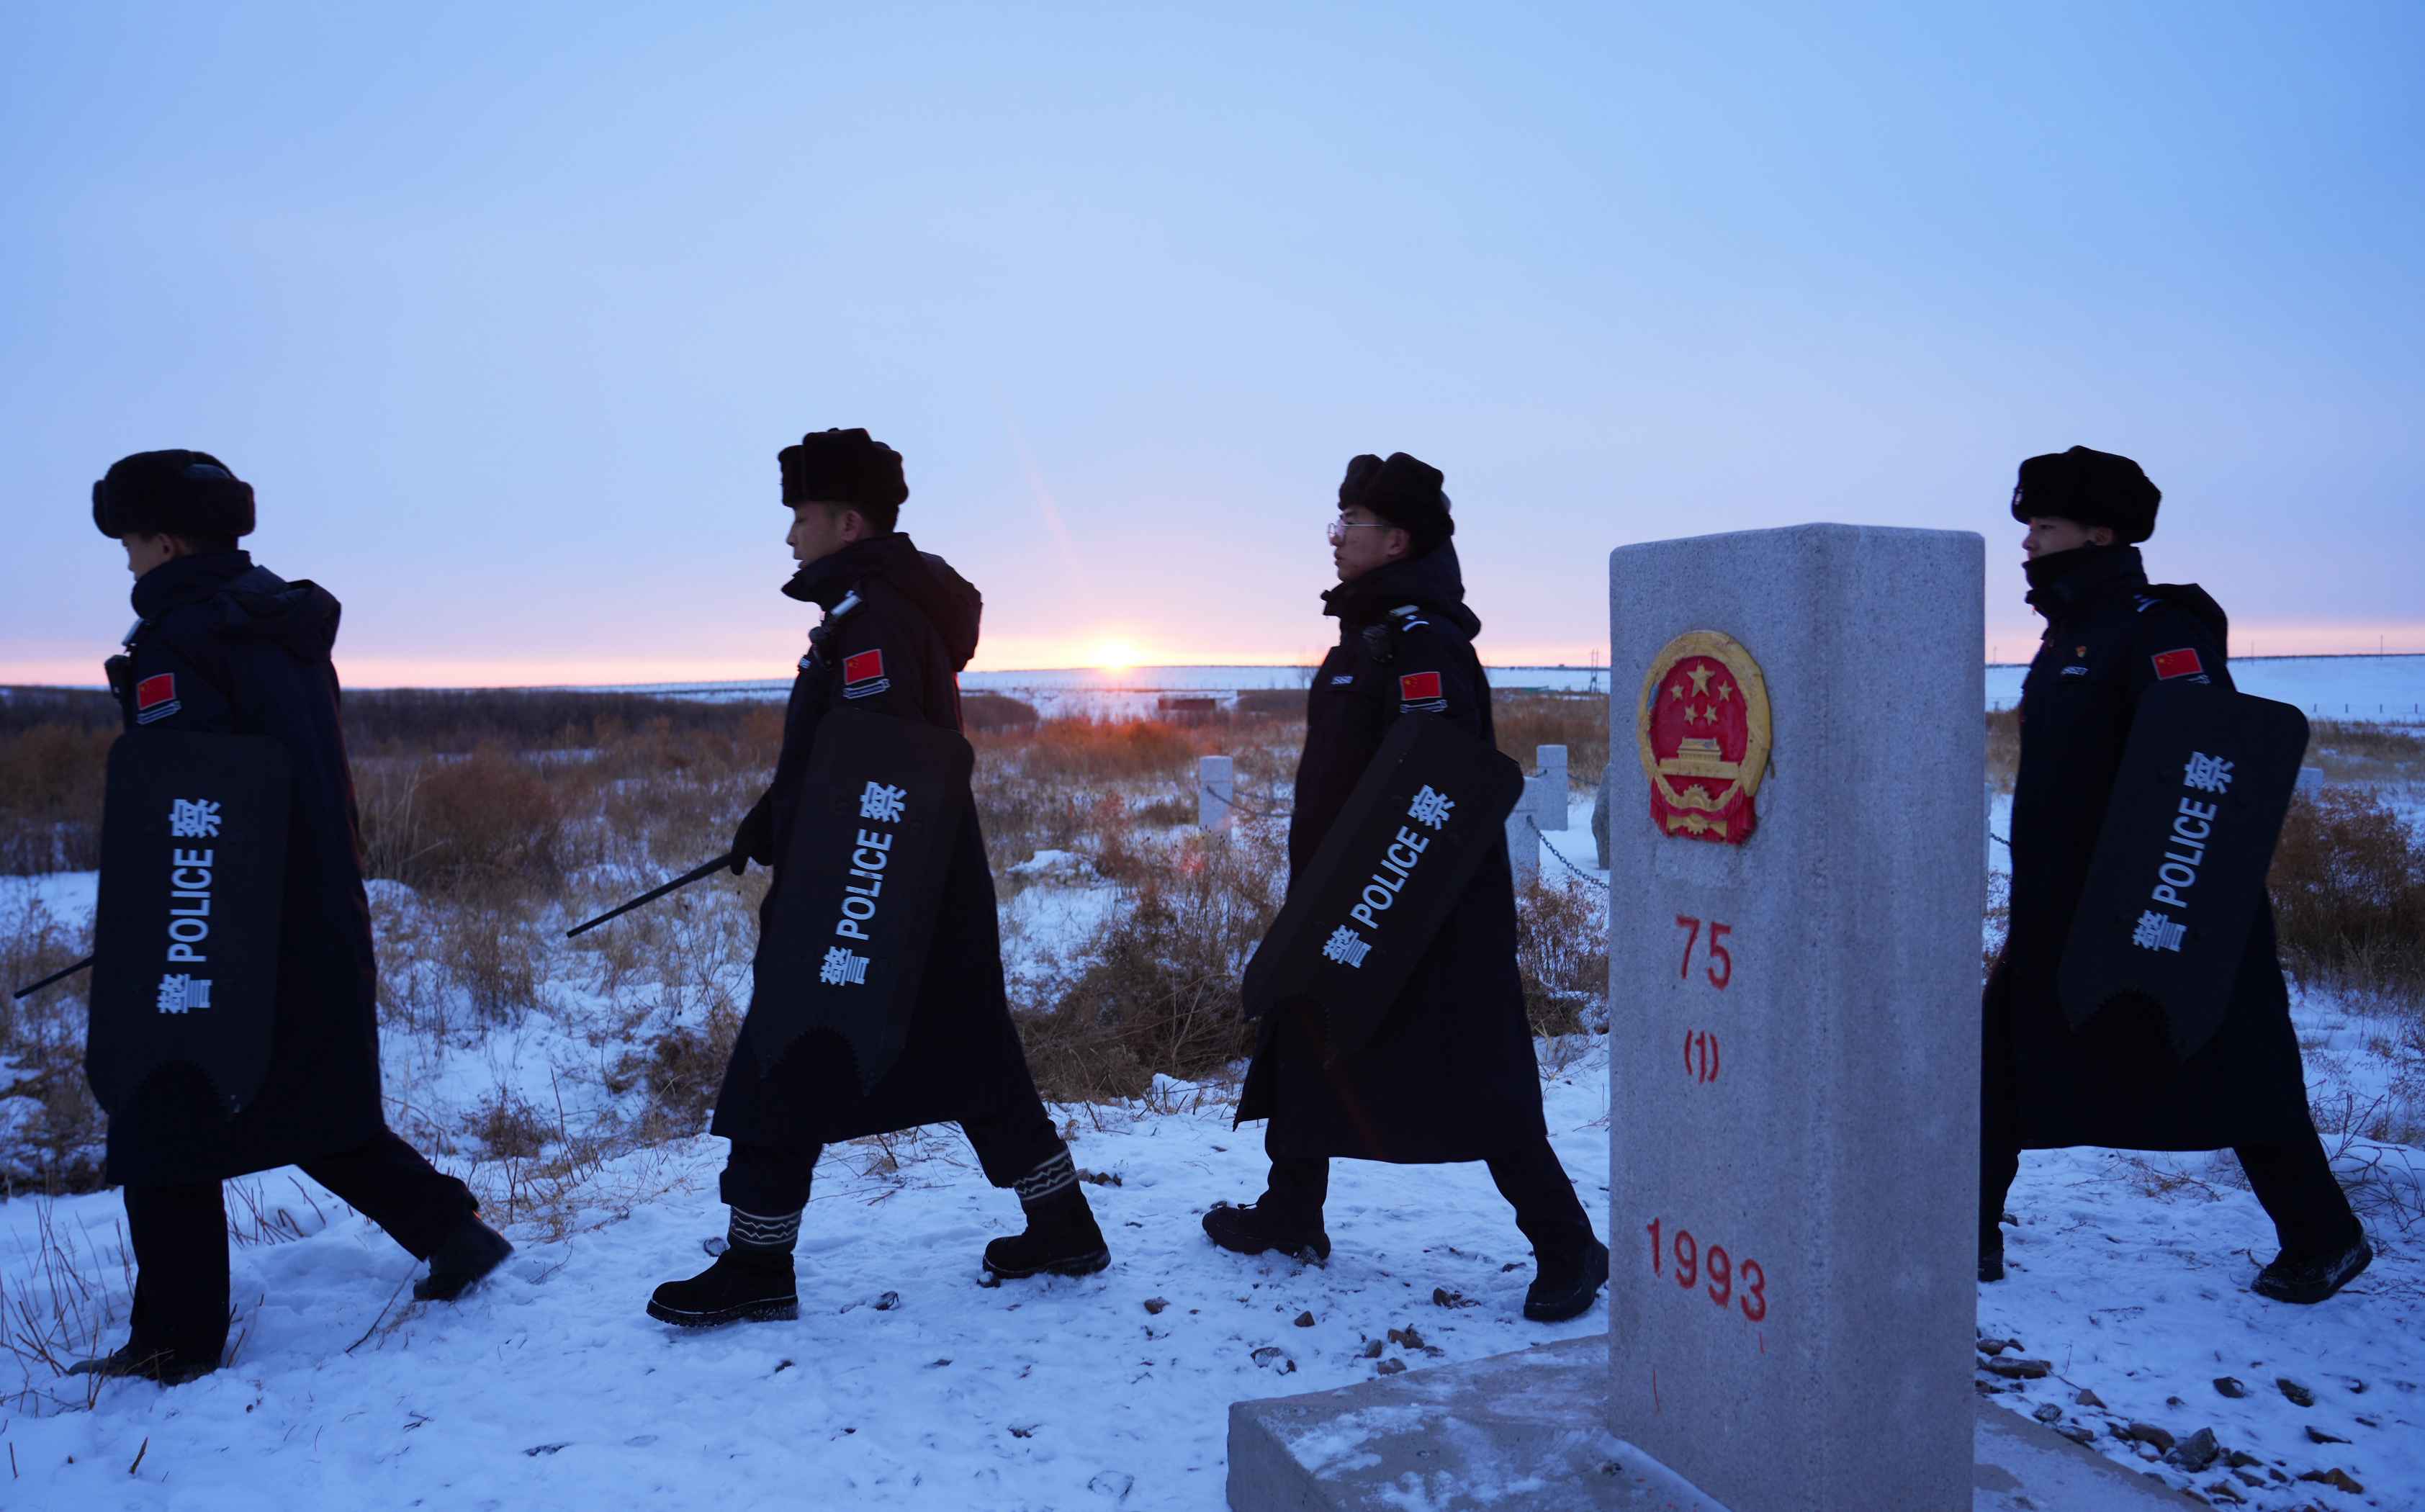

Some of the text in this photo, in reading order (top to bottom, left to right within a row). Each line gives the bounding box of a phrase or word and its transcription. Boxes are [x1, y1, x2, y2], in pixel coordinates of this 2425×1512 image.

[157, 798, 222, 1014] 警 POLICE 察
[819, 780, 907, 986] 警 POLICE 察
[1322, 784, 1455, 968] 警 POLICE 察
[2133, 751, 2233, 952] 警 POLICE 察
[1675, 914, 1732, 990] 75
[1683, 1027, 1719, 1084] (1)
[1647, 1217, 1766, 1322] 1993
